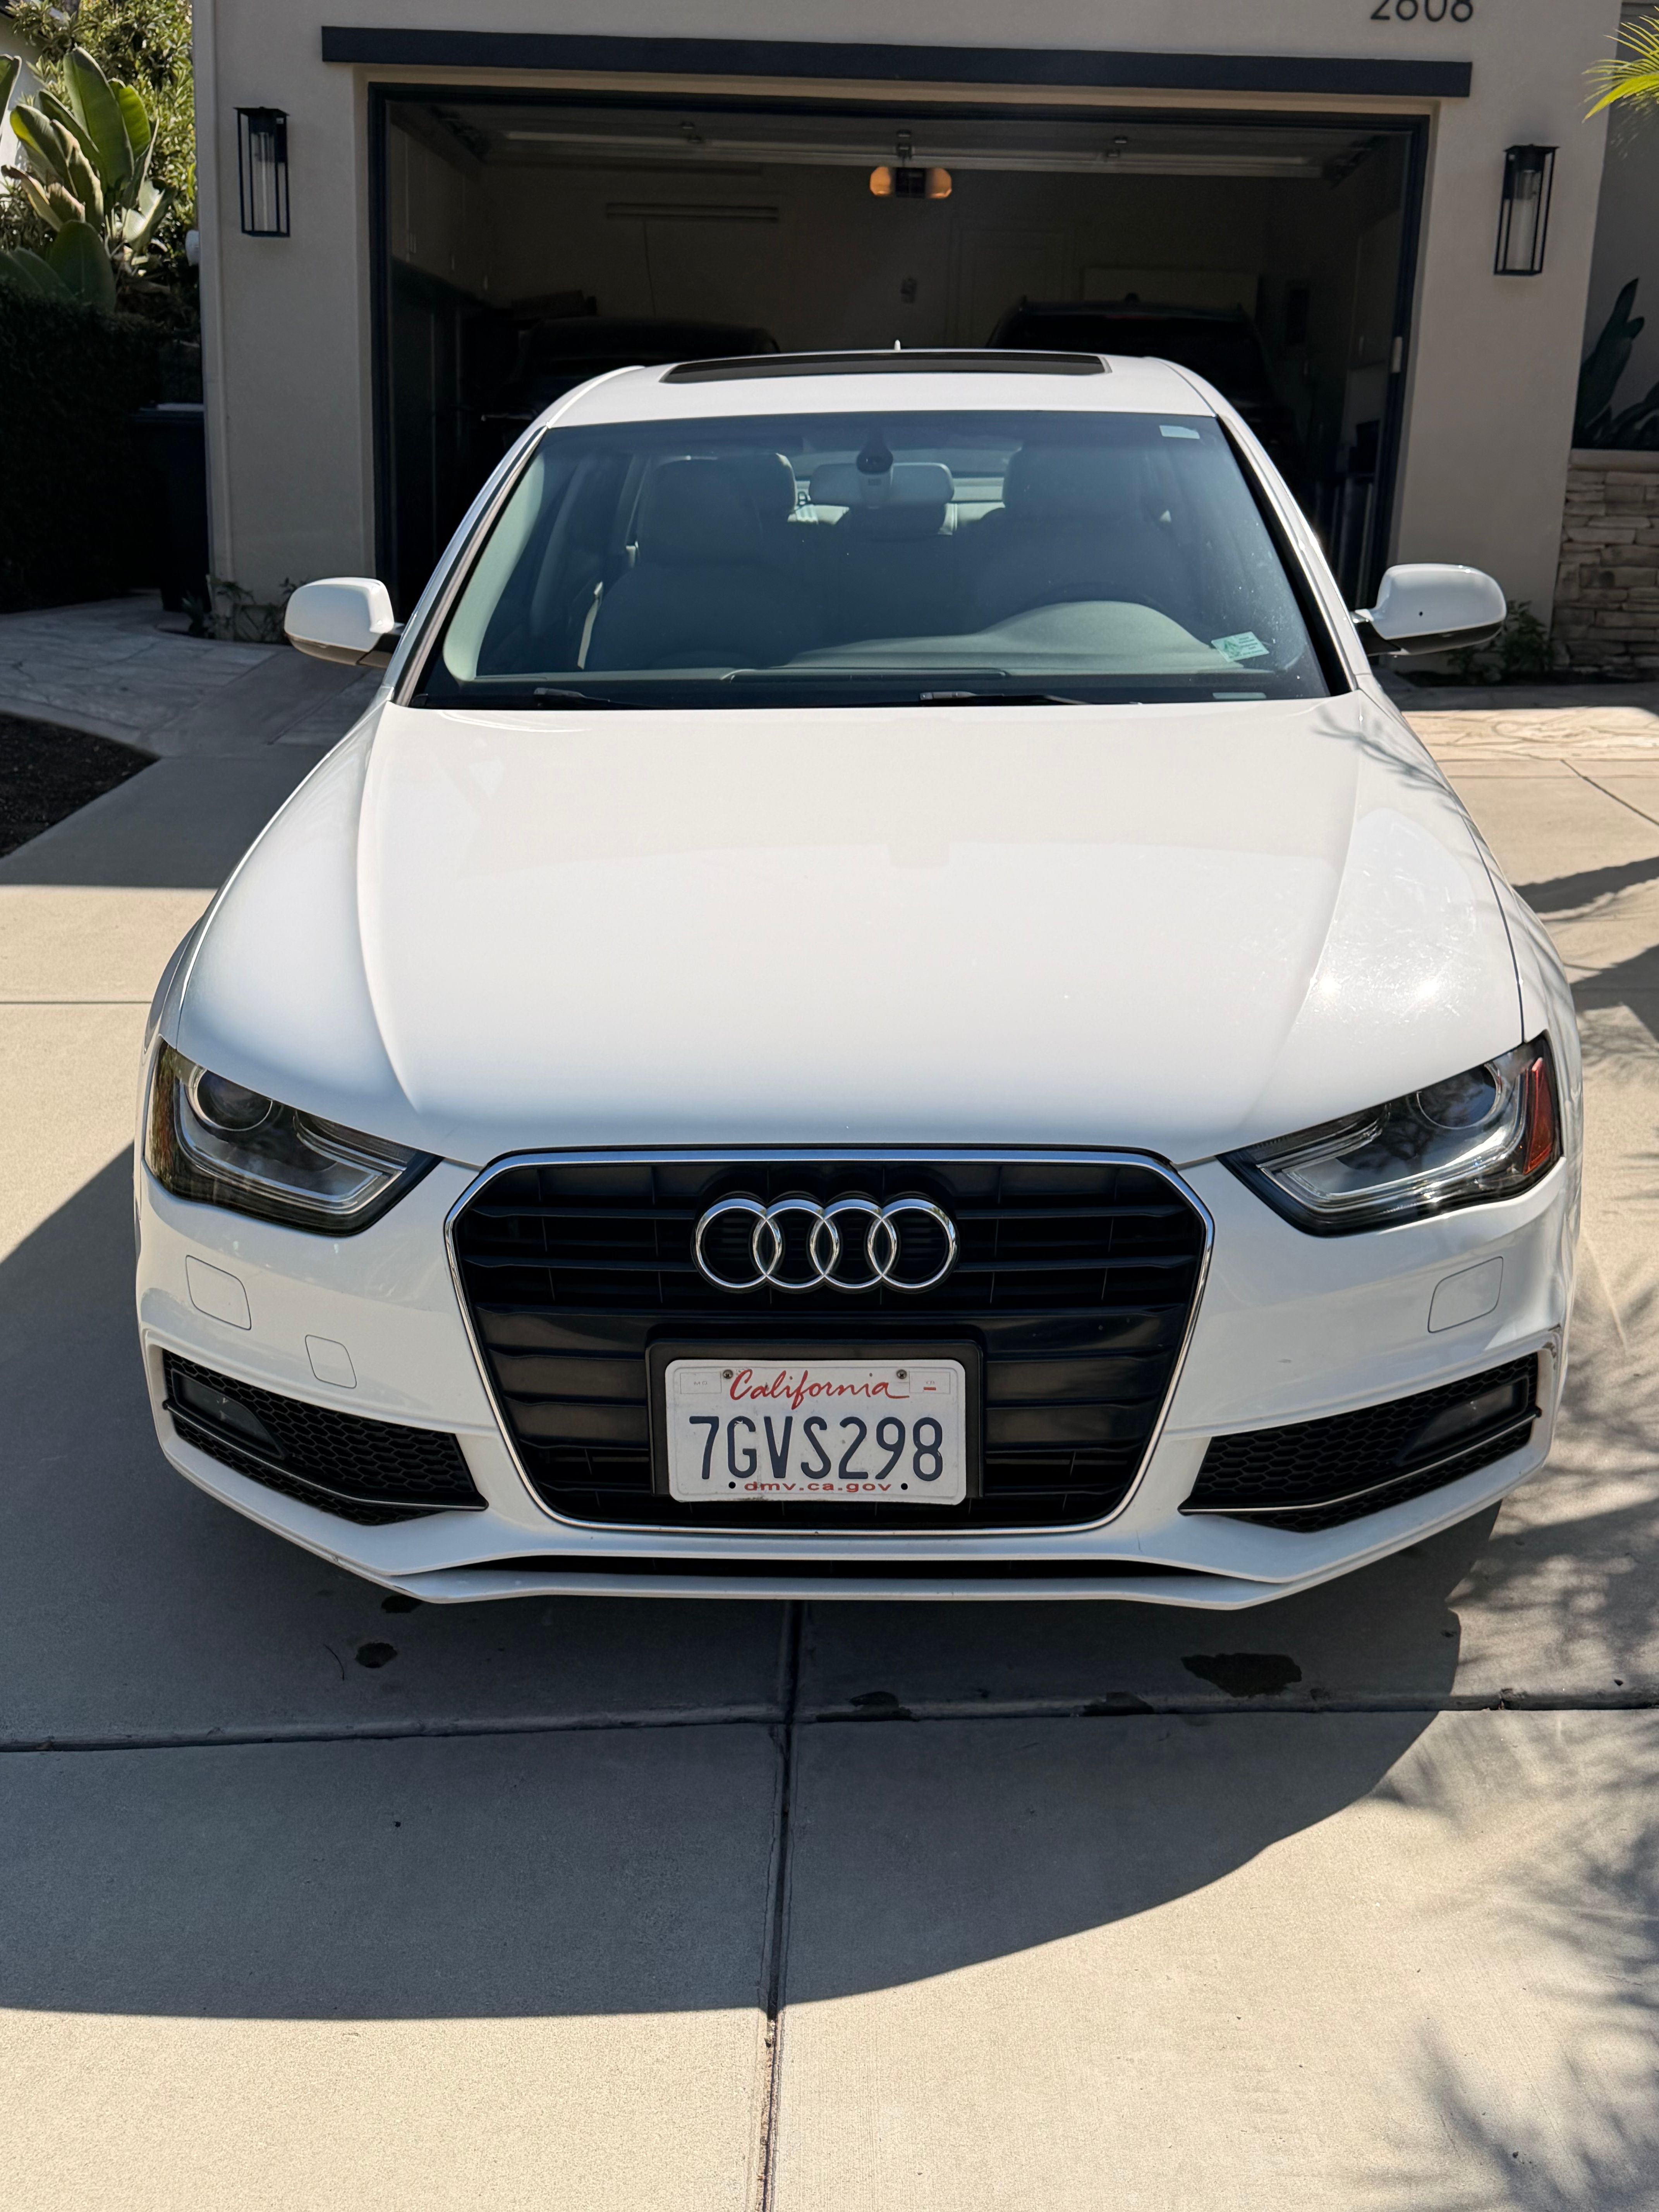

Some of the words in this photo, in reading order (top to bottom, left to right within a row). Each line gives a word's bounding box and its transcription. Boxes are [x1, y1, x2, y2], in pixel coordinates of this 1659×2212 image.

[729, 1369, 910, 1410] California
[689, 1416, 943, 1482] 7GVS298
[744, 1482, 892, 1492] dmv.ca.gov
